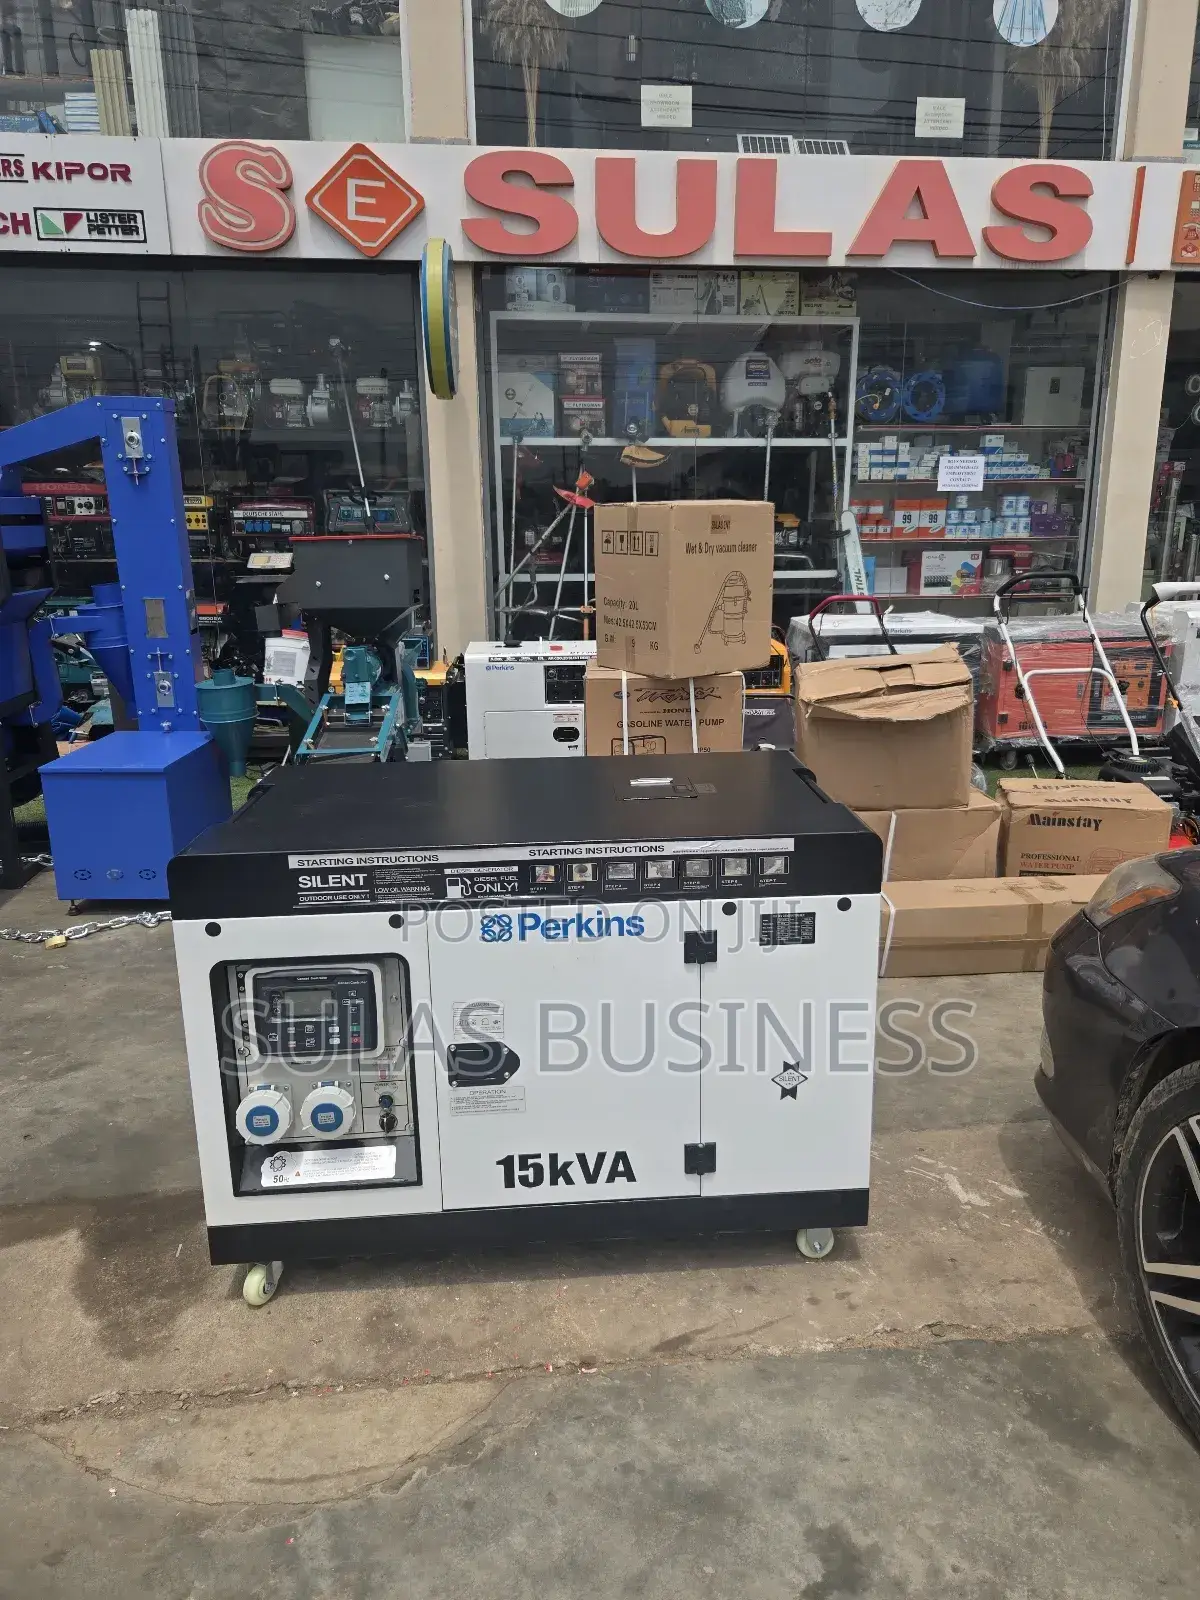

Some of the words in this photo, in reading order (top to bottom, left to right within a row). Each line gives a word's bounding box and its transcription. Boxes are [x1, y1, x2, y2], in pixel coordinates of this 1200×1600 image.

[31, 161, 133, 182] KIPOR
[198, 139, 295, 252] S
[346, 177, 387, 224] E
[461, 150, 1094, 262] SULAS
[86, 212, 138, 224] LISTER
[87, 224, 140, 236] PETTER
[34, 482, 91, 491] HONDA
[902, 514, 912, 524] 99
[928, 513, 938, 524] 99
[685, 542, 697, 555] Wet
[698, 541, 703, 554] &
[704, 541, 715, 556] Dry
[716, 544, 736, 554] vacuum
[738, 541, 757, 553] cleaner
[629, 600, 639, 611] 20L
[649, 640, 659, 651] KG
[699, 718, 725, 727] PUMP
[1026, 811, 1103, 832] Mainstay
[528, 846, 583, 857] STARTING
[585, 844, 665, 855] INSTRUCTIONS
[297, 857, 340, 867] STARTING
[356, 854, 440, 865] INSTRUCTIONS
[1020, 852, 1082, 862] PROFESSIONAL
[1020, 862, 1050, 870] WATER
[1050, 862, 1075, 870] PUMP
[298, 873, 368, 889] SILENT
[400, 885, 431, 893] WARNING
[473, 882, 519, 893] ONLY!
[517, 911, 645, 942] Perkins
[496, 1150, 637, 1189] 15kVA
